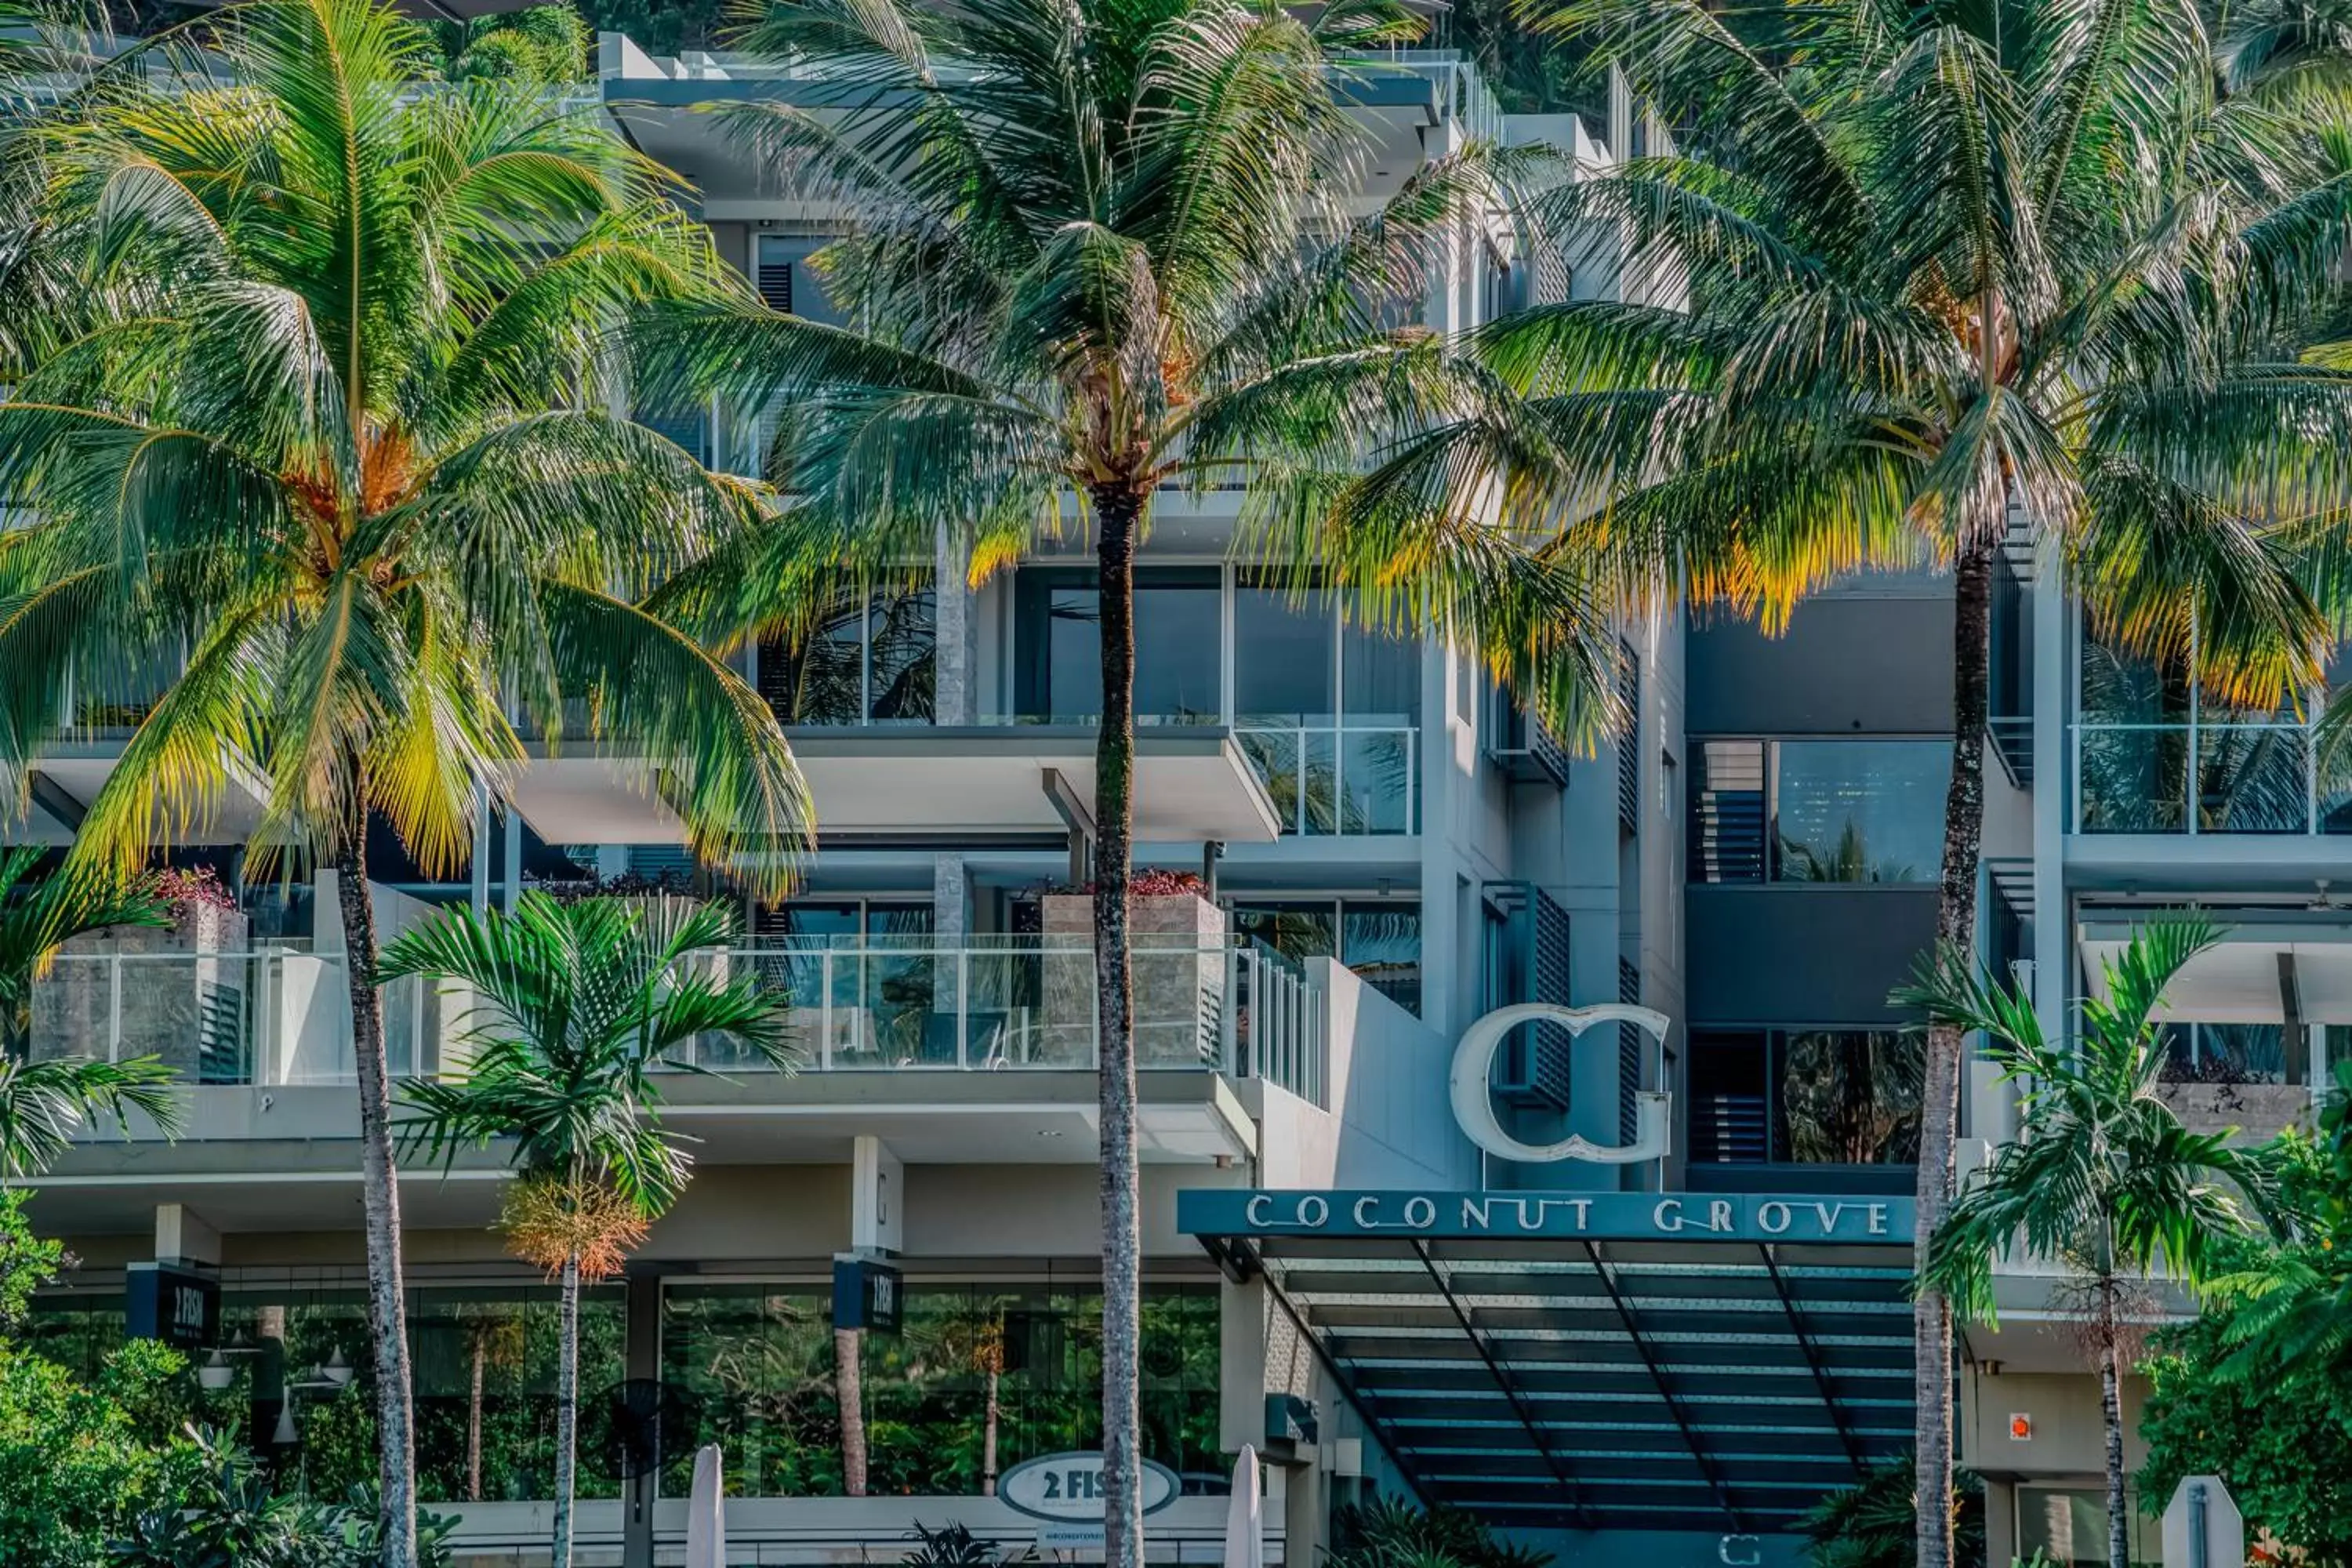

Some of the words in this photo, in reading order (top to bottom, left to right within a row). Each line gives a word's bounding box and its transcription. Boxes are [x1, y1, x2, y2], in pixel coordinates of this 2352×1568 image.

[1245, 1194, 1593, 1231] COCONUT
[1653, 1199, 1889, 1236] GROVE
[1044, 1470, 1061, 1499] 2
